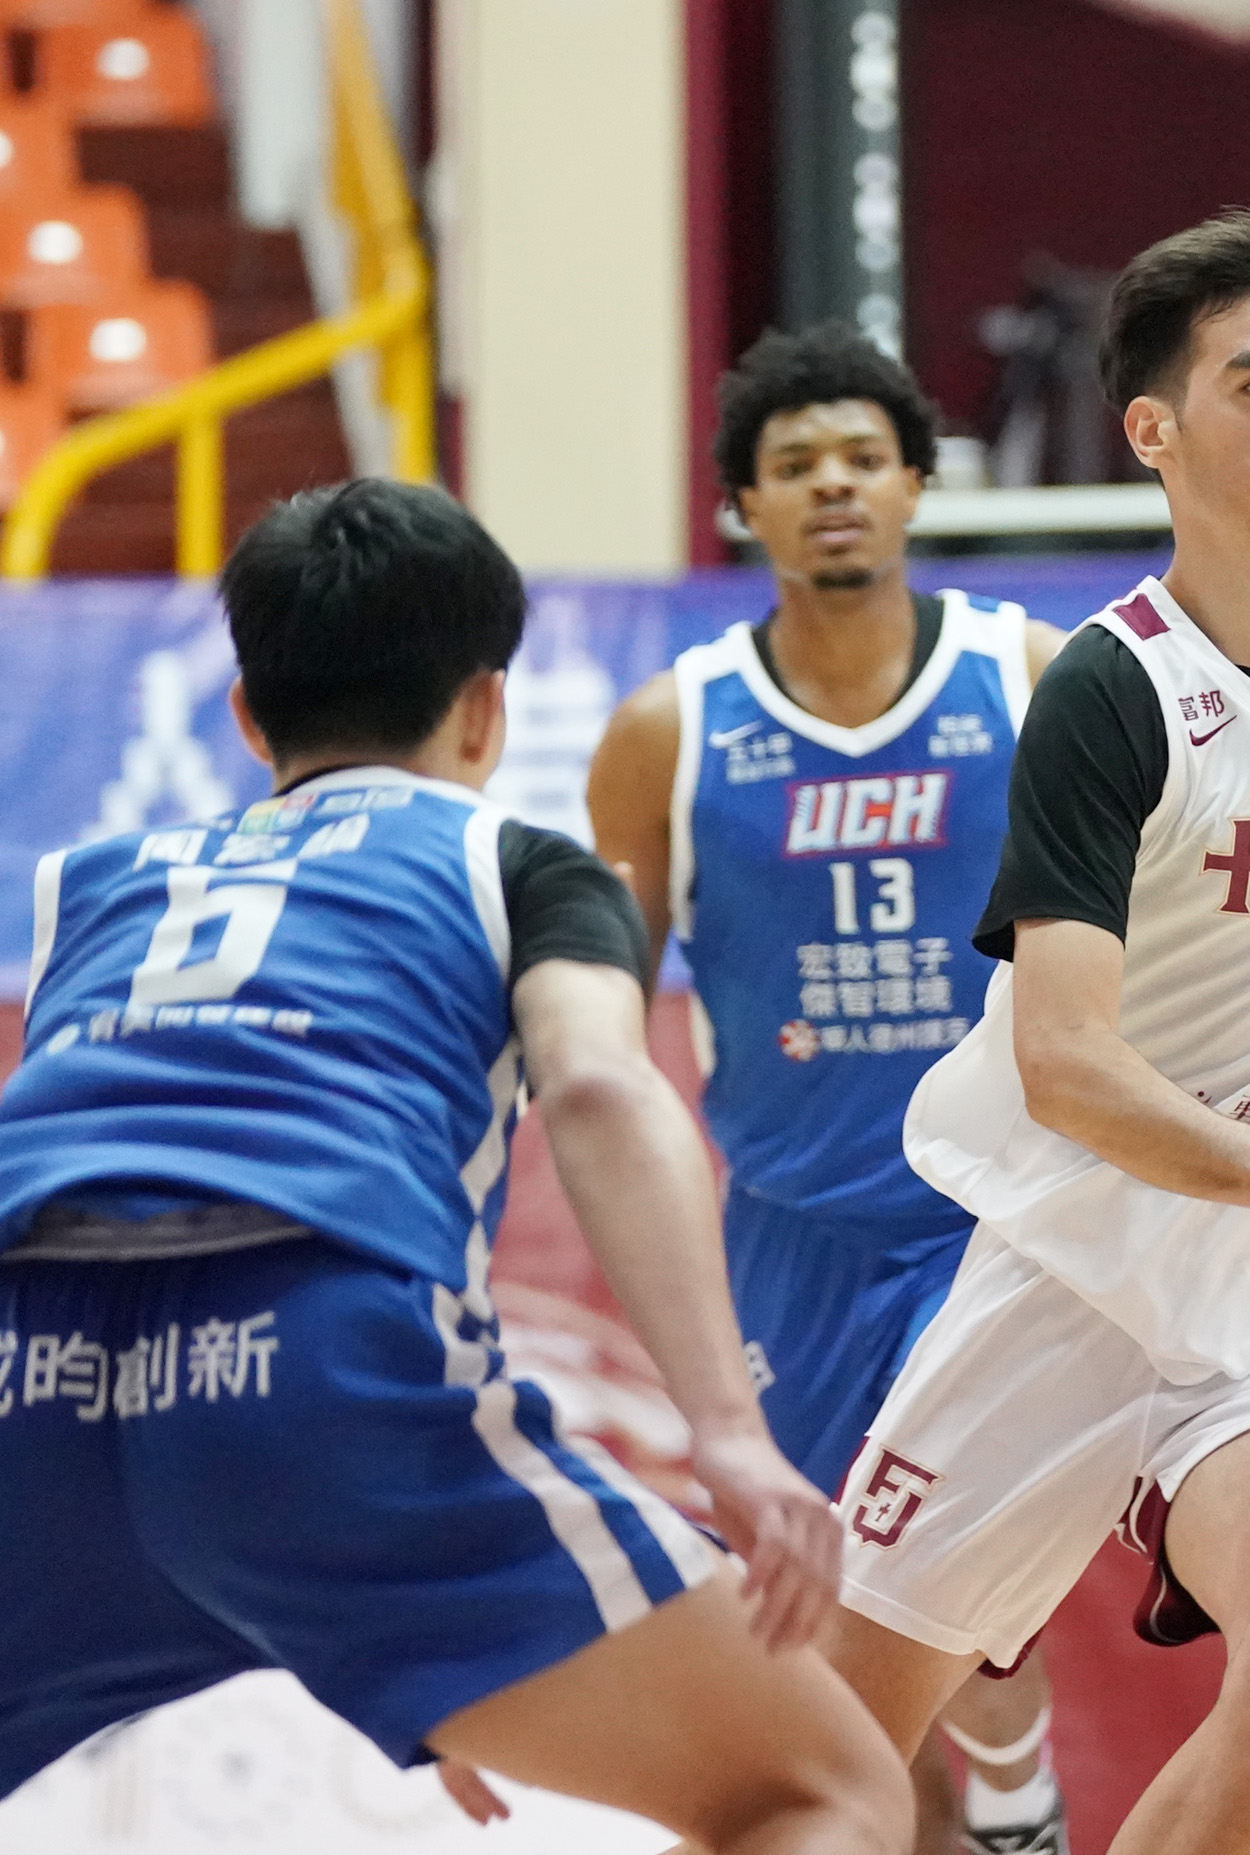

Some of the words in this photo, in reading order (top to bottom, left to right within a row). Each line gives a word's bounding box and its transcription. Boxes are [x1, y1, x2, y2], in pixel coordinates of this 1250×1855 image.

[1178, 690, 1225, 721] 富邦
[786, 773, 948, 854] UCH
[129, 858, 298, 1003] 6
[829, 857, 916, 934] 13
